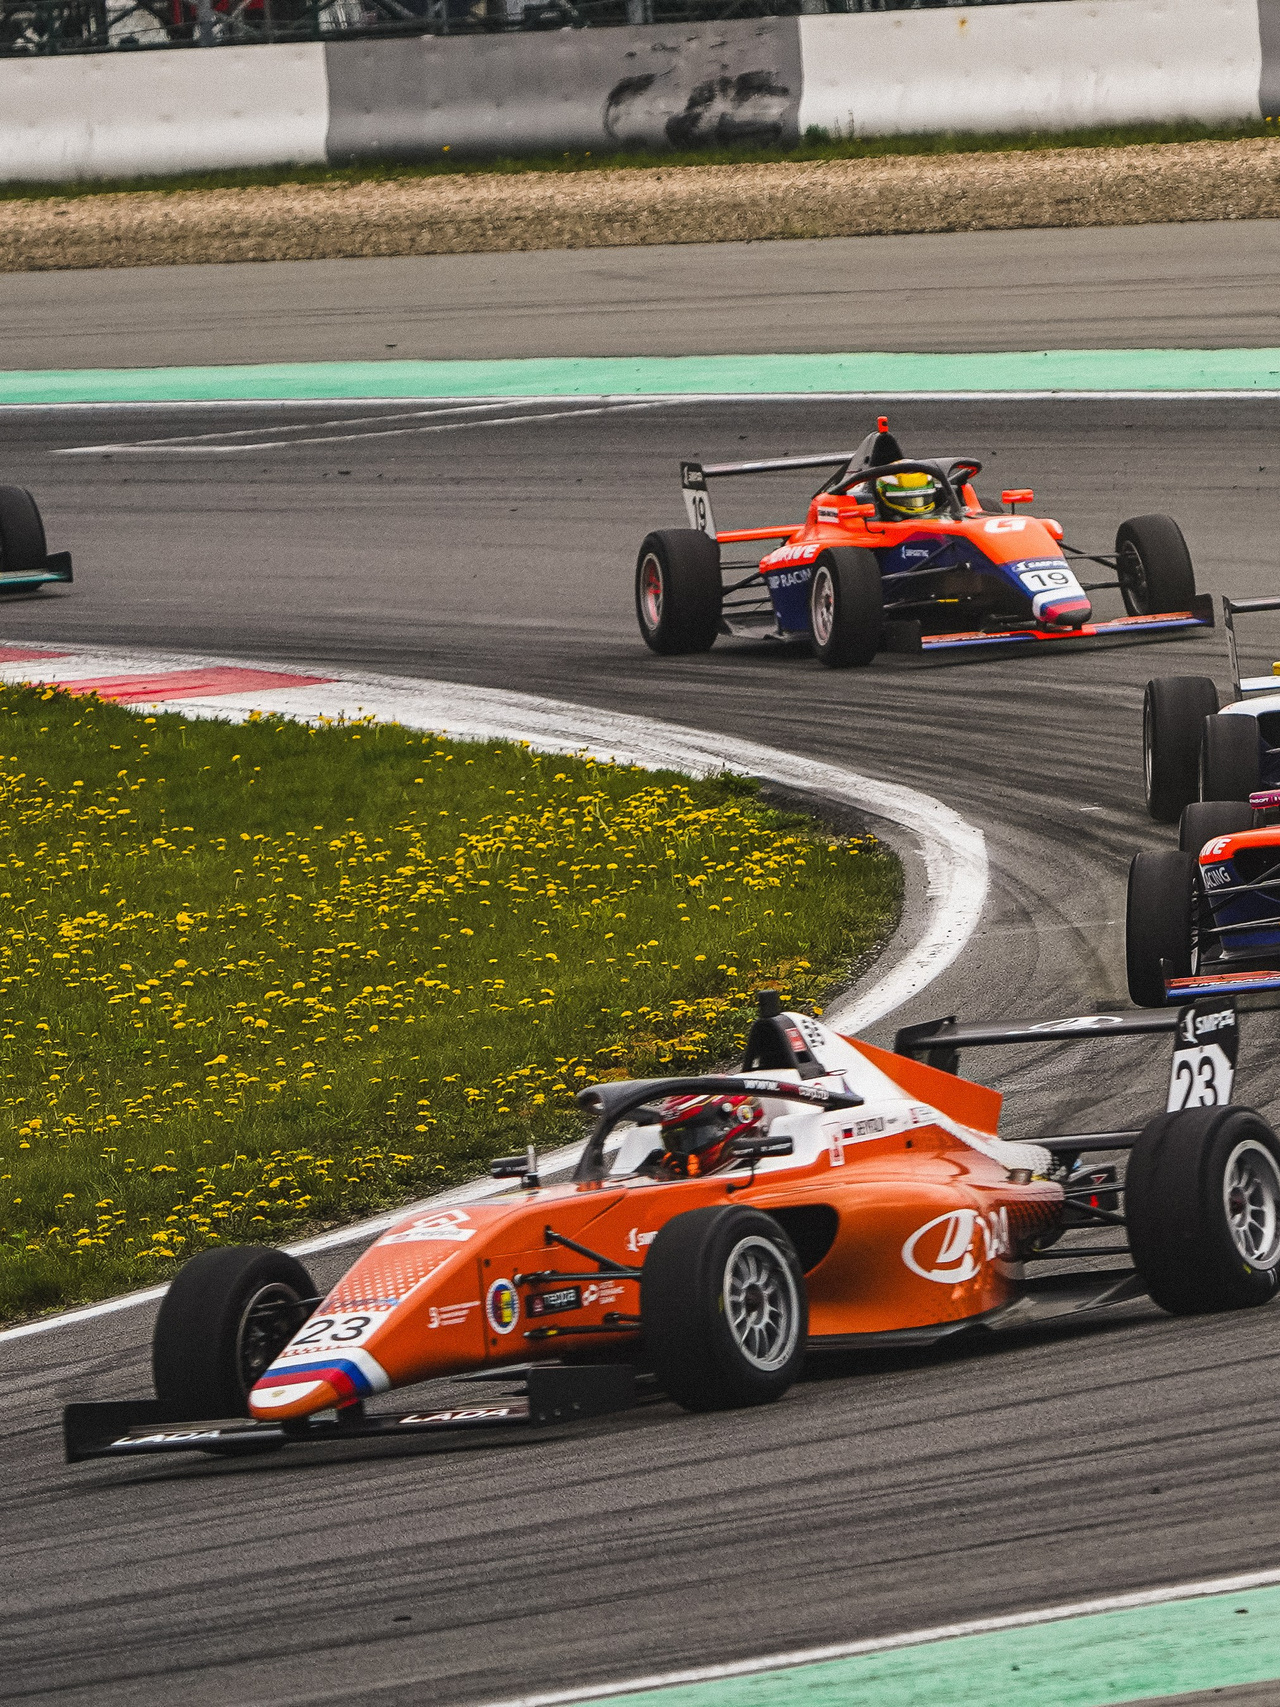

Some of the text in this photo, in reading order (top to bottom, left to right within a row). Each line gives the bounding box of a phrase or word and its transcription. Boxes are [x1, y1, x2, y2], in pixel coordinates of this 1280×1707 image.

[1031, 573, 1068, 586] 19
[1176, 1055, 1218, 1110] 23
[291, 1316, 371, 1346] 23
[399, 1408, 511, 1424] LADA
[109, 1430, 222, 1447] LADA
